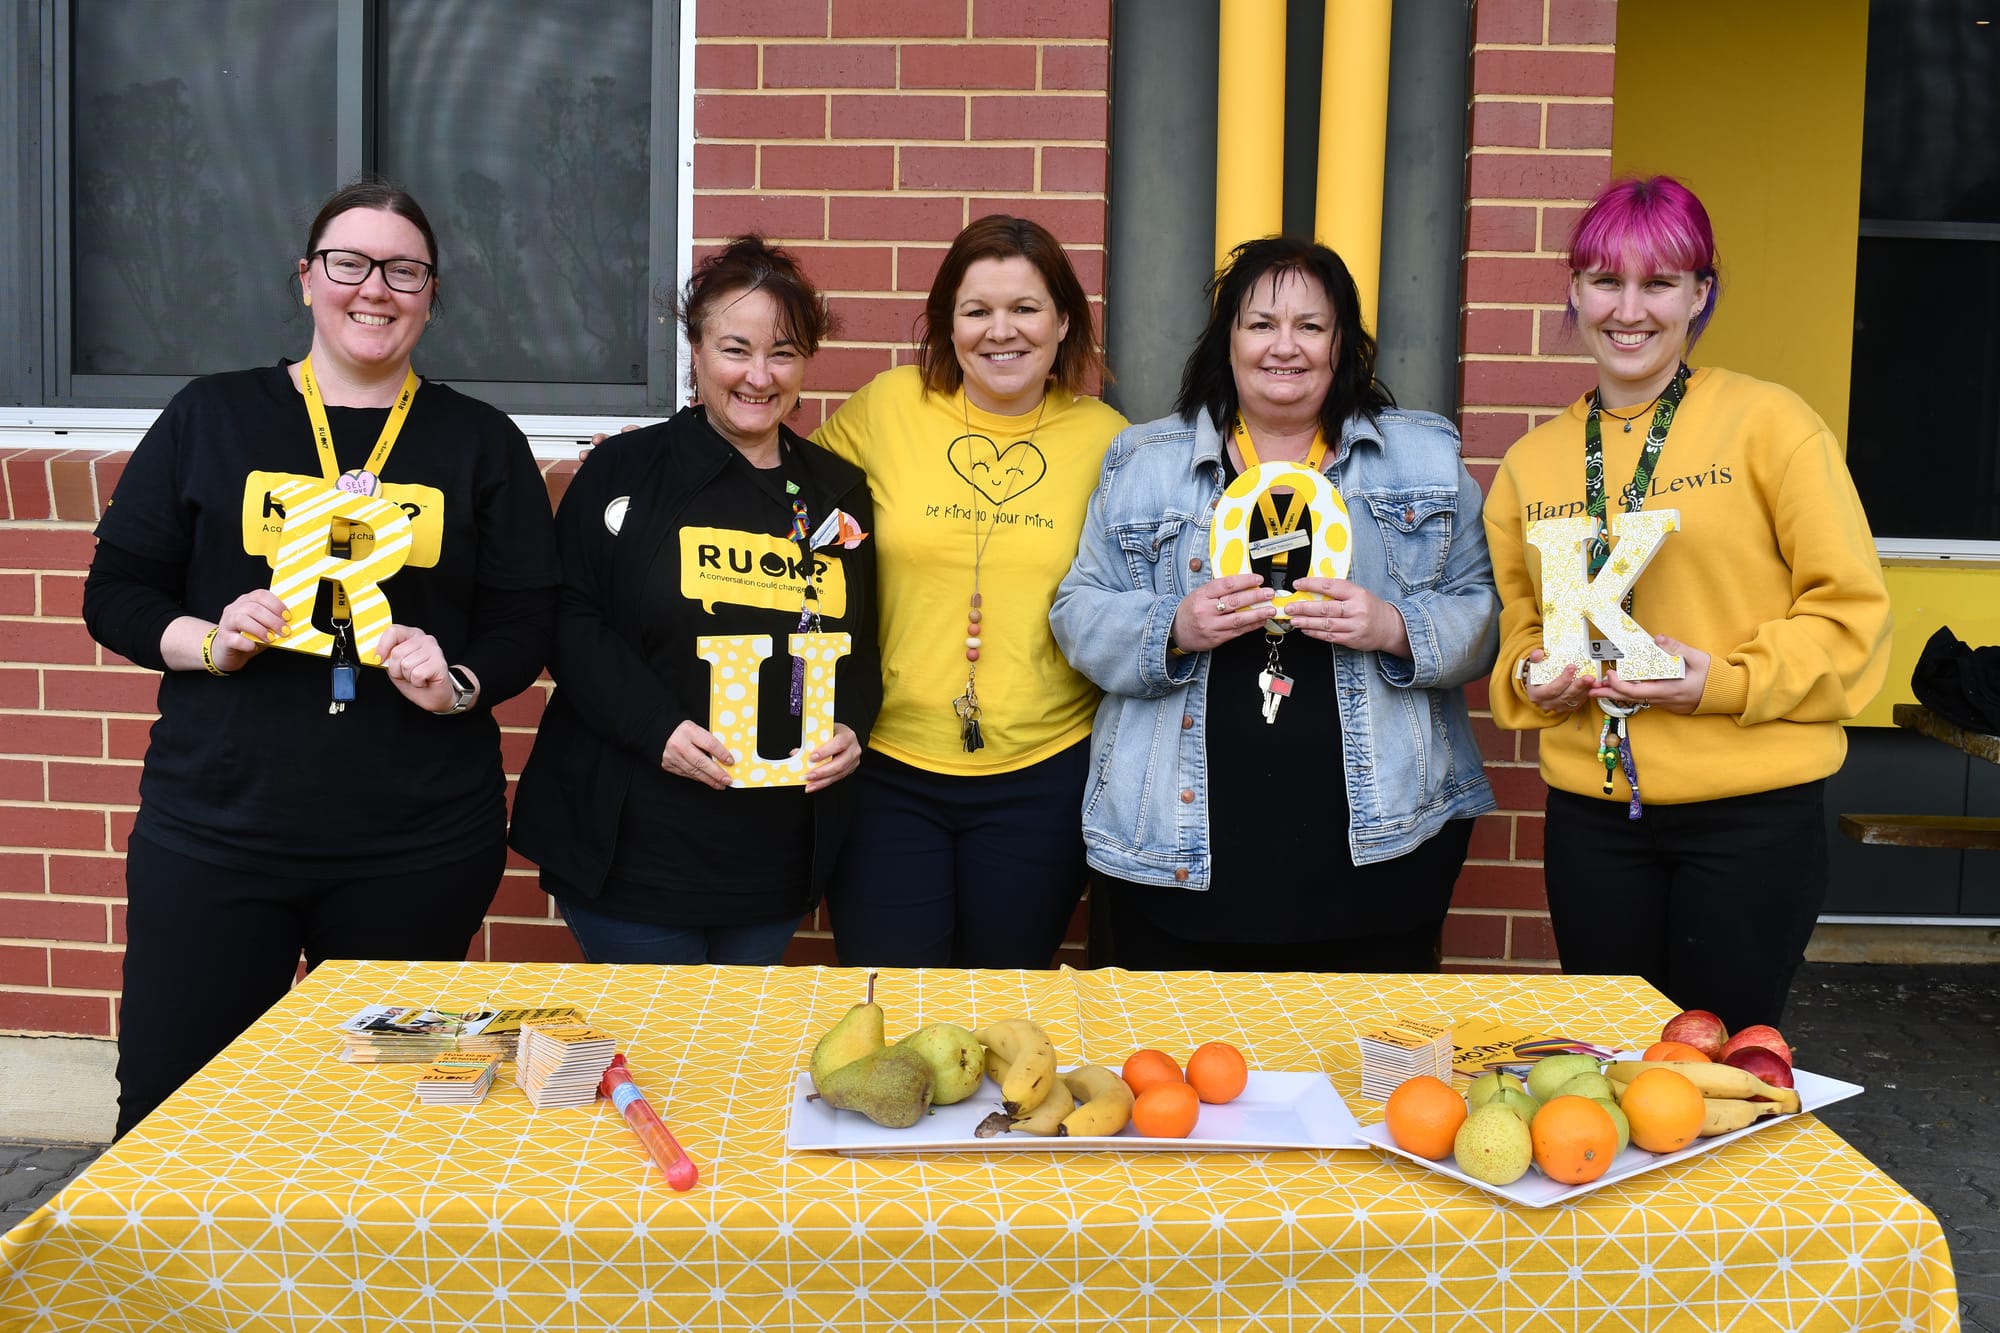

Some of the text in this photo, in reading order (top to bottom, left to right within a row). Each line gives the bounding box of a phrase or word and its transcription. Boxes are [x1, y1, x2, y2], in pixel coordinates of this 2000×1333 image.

[345, 480, 368, 490] SELF
[1649, 463, 1733, 498] Lewis
[926, 503, 1054, 529] be kind to your mind
[241, 479, 414, 668] R
[699, 571, 706, 579] A
[706, 573, 756, 587] conversation
[756, 581, 778, 590] could
[778, 583, 806, 594] change
[1527, 509, 1686, 685] K
[696, 633, 852, 788] U
